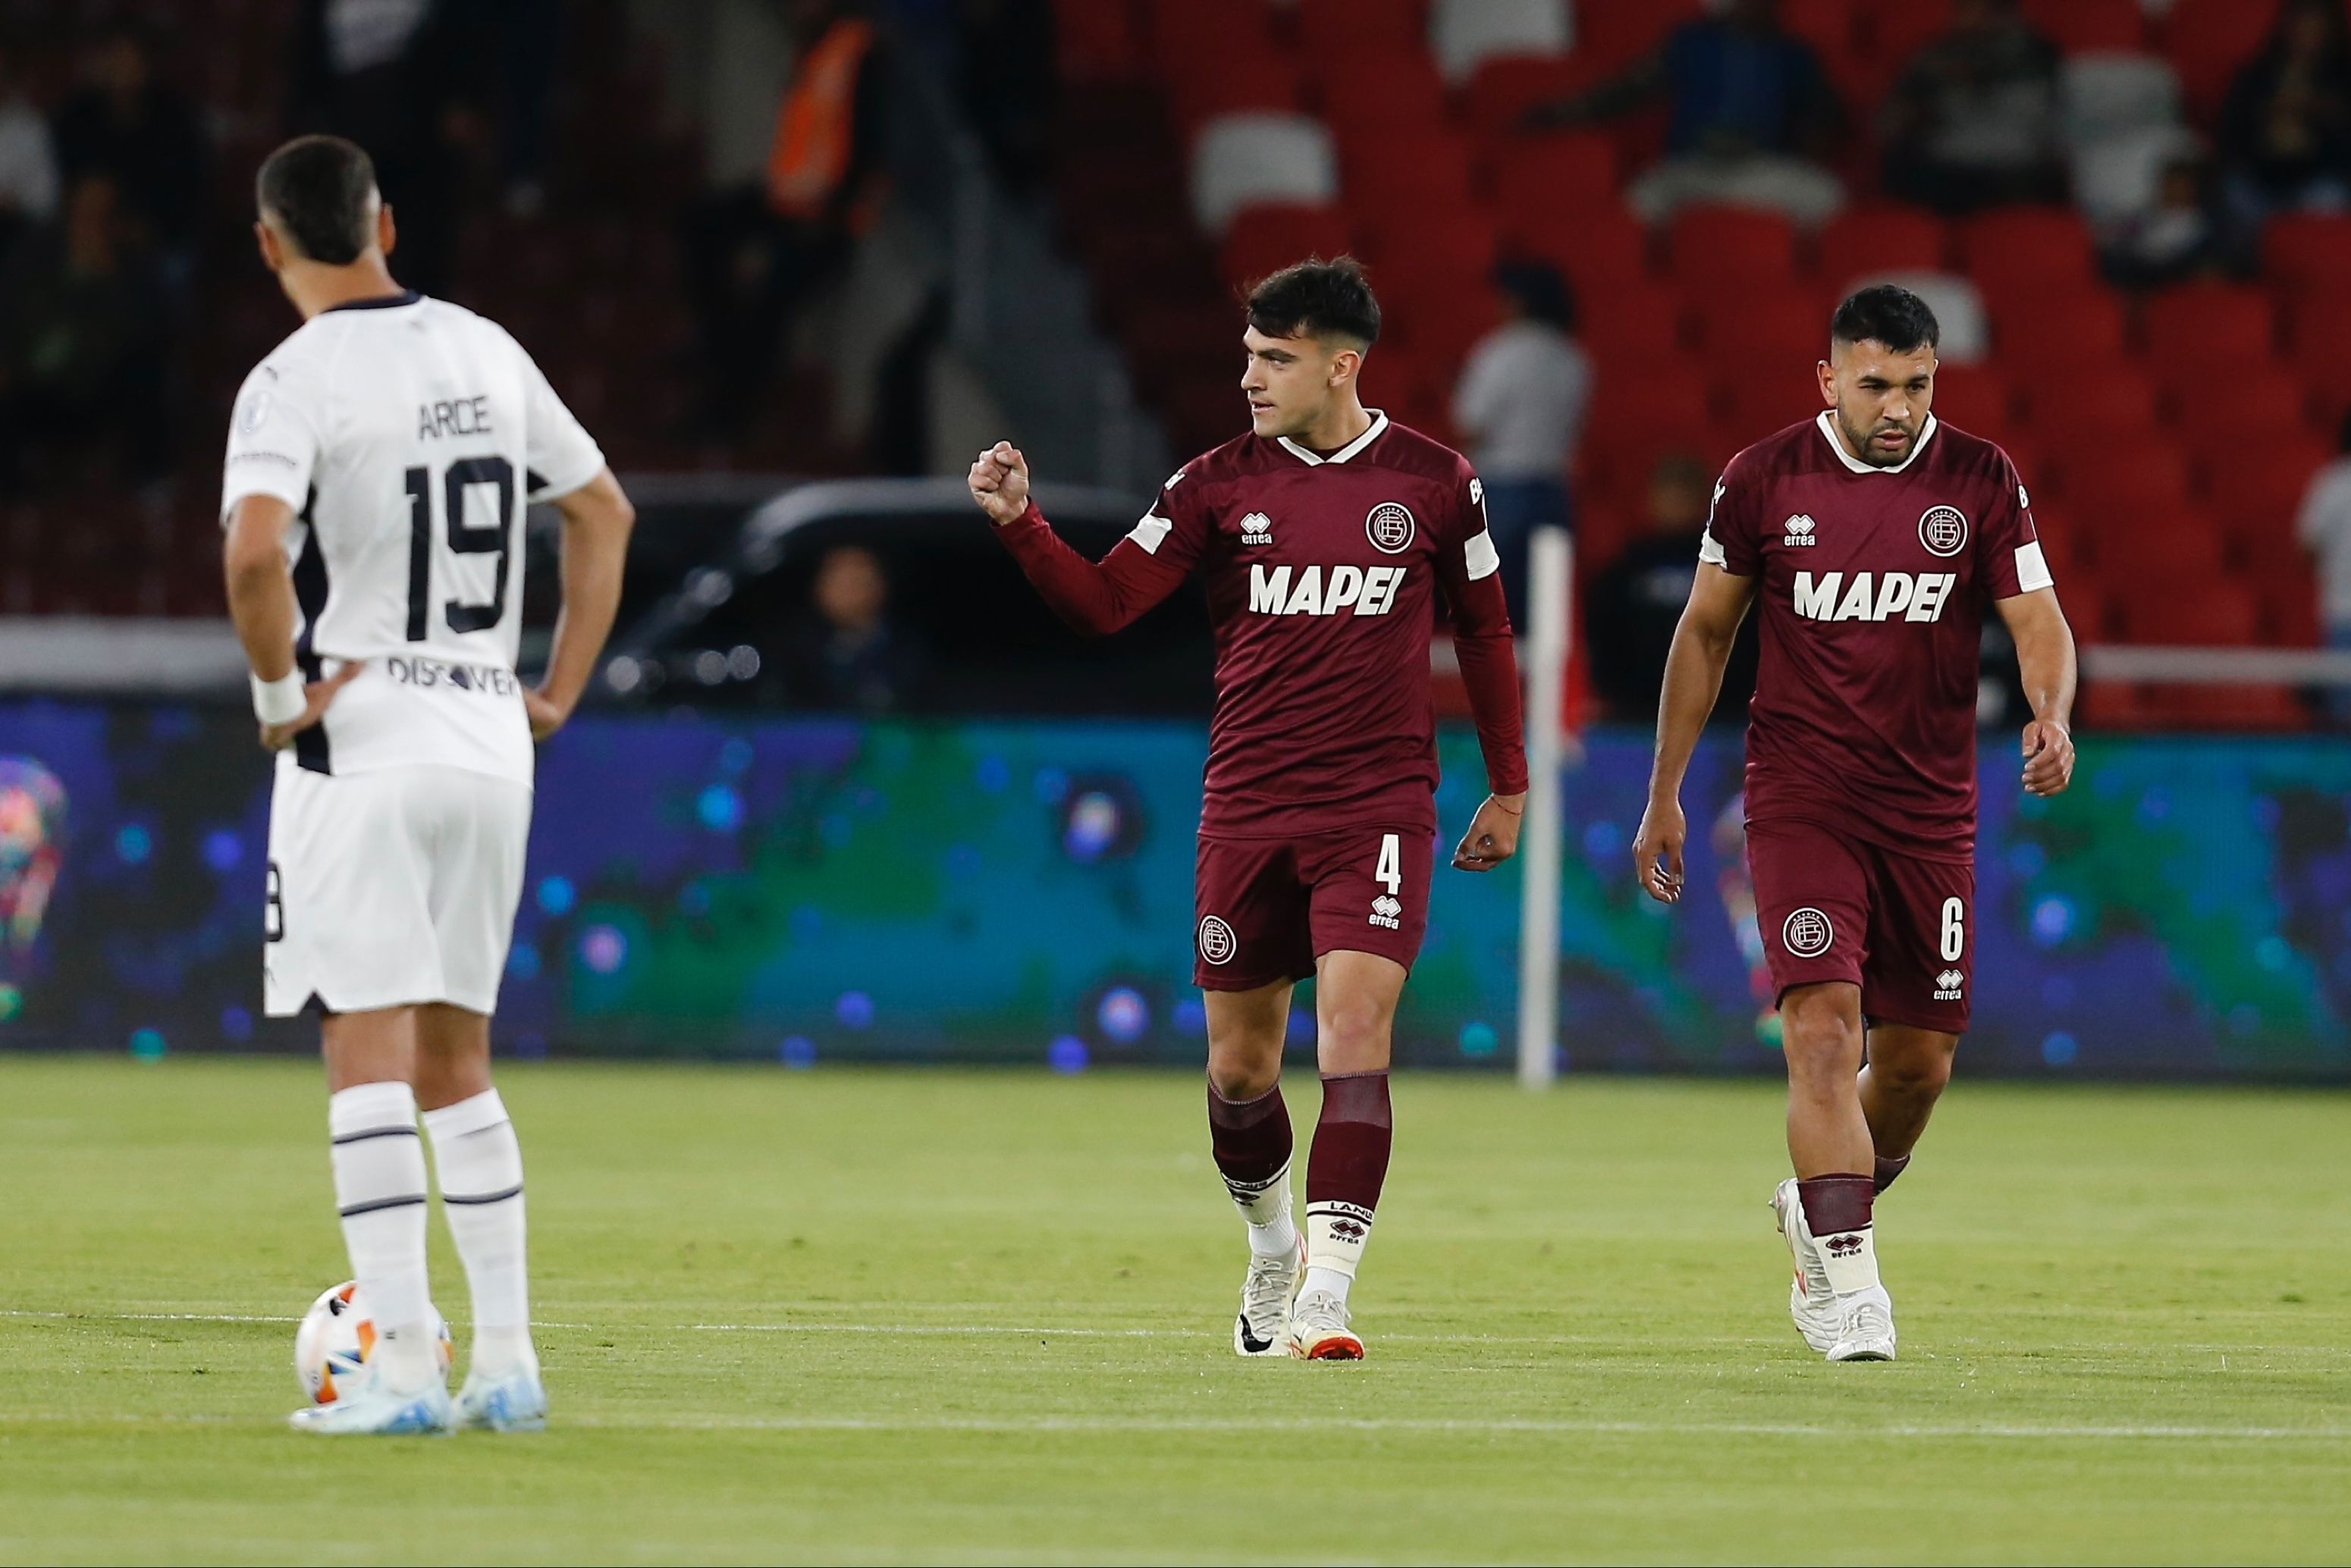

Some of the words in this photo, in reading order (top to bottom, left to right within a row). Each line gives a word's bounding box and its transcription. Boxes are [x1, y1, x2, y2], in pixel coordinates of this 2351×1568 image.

[419, 395, 491, 440] ARCE
[405, 456, 514, 642] 19
[1249, 564, 1407, 616] MAPEI
[1794, 571, 1957, 622] MAPEI
[1376, 834, 1401, 895] 4
[1940, 897, 1963, 961] 6
